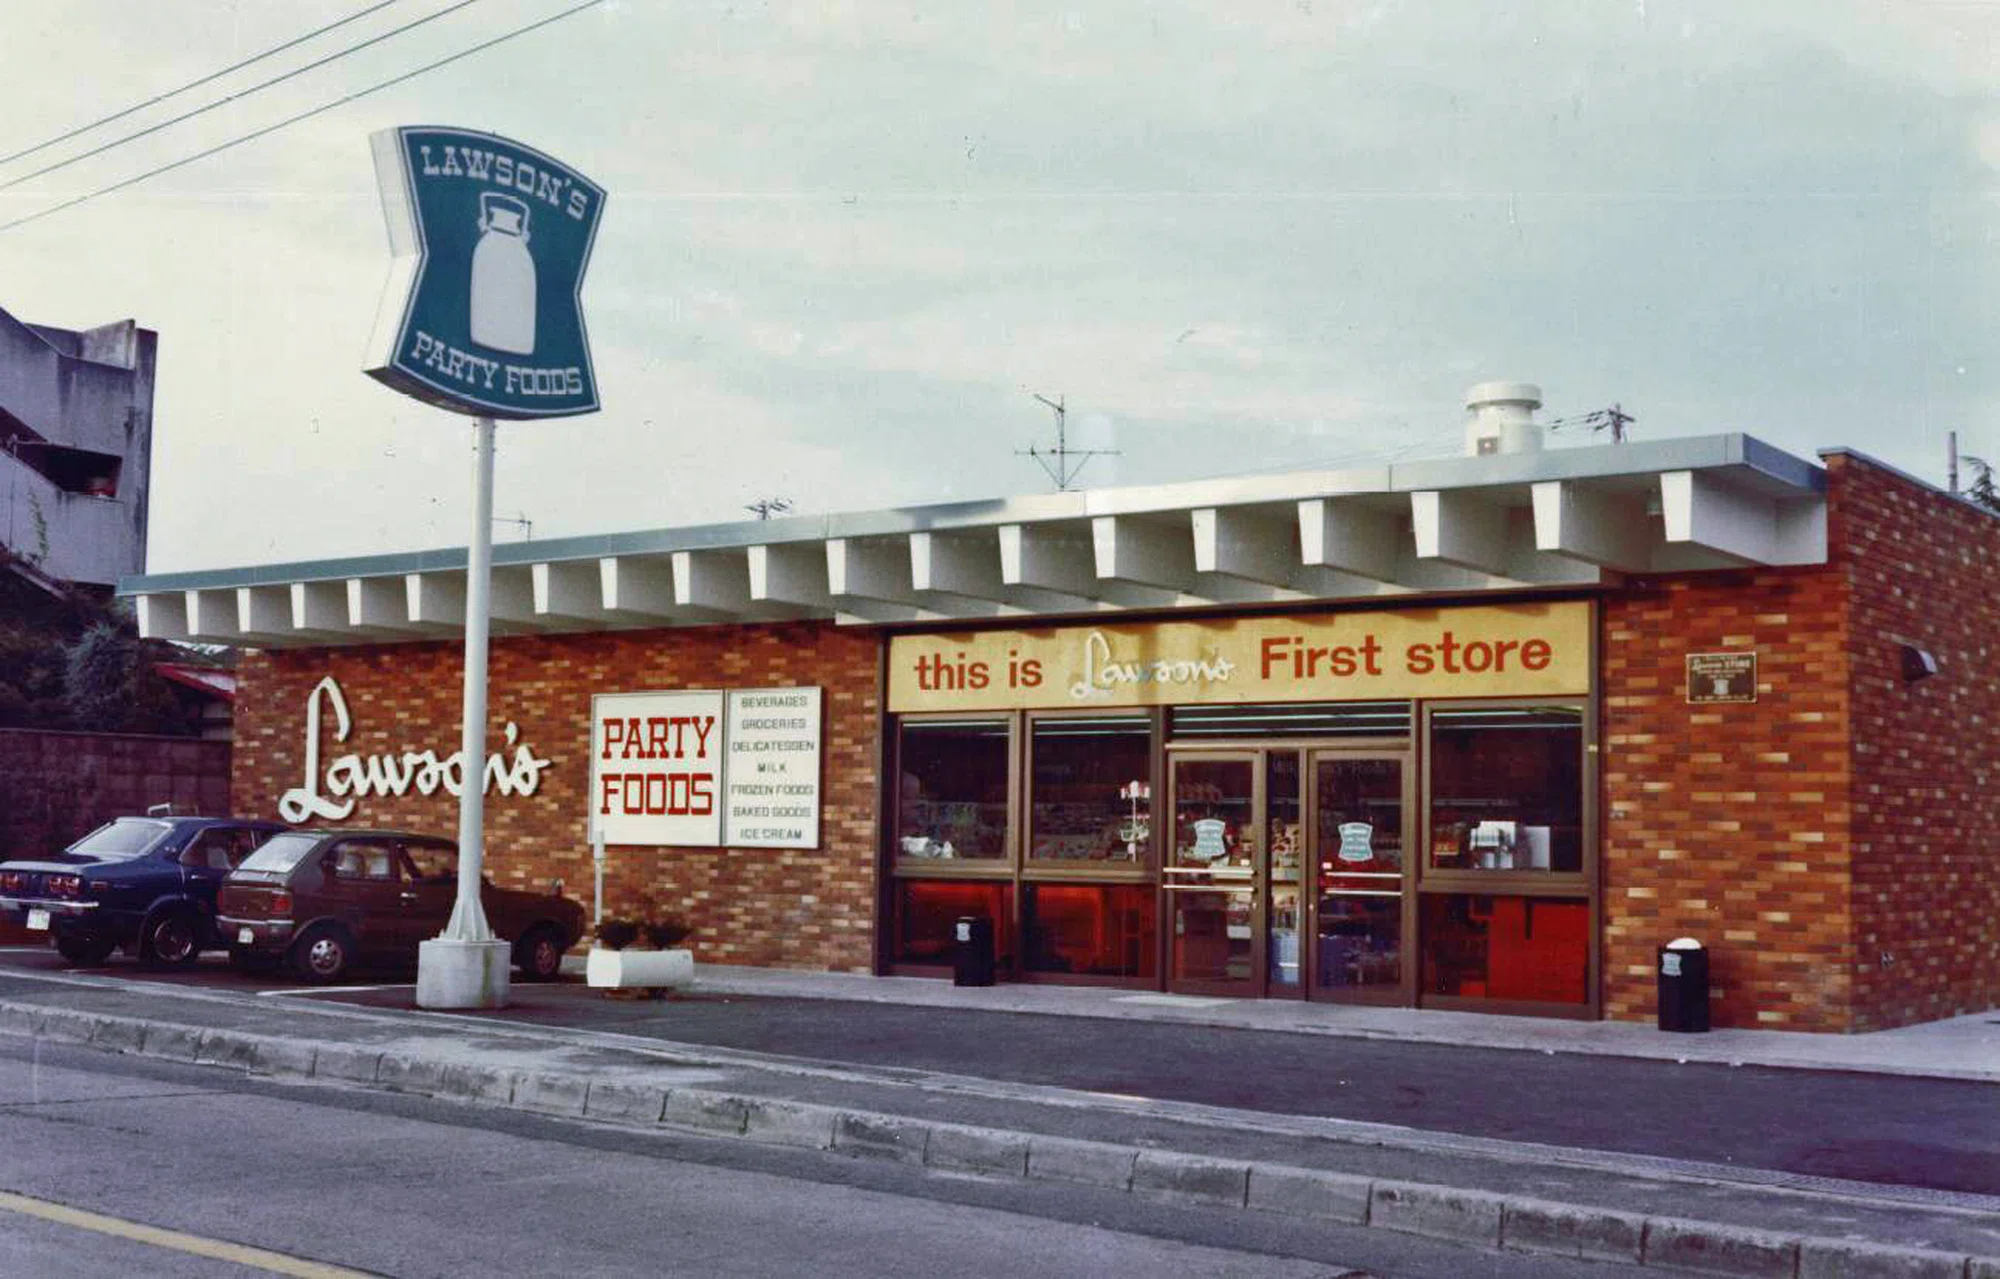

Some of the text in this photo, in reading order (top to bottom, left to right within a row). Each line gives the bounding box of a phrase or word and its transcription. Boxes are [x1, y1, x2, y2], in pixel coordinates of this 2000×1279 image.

[420, 145, 589, 221] LAWSON'S
[411, 331, 583, 396] PARTY FOODS
[914, 652, 989, 691] this
[1009, 650, 1042, 688] is
[1260, 634, 1383, 680] First
[1406, 631, 1553, 675] store
[741, 695, 808, 708] BEVERAGES
[742, 718, 807, 730] GROCERIES
[601, 716, 715, 760] PARTY
[732, 741, 815, 752] DELICATESSEN
[757, 763, 787, 773] MILK
[601, 772, 714, 816] FOODS
[731, 784, 814, 796] FROZEN FOODS
[733, 806, 812, 818] BAKED GOODS
[740, 828, 802, 840] ICE CREAM
